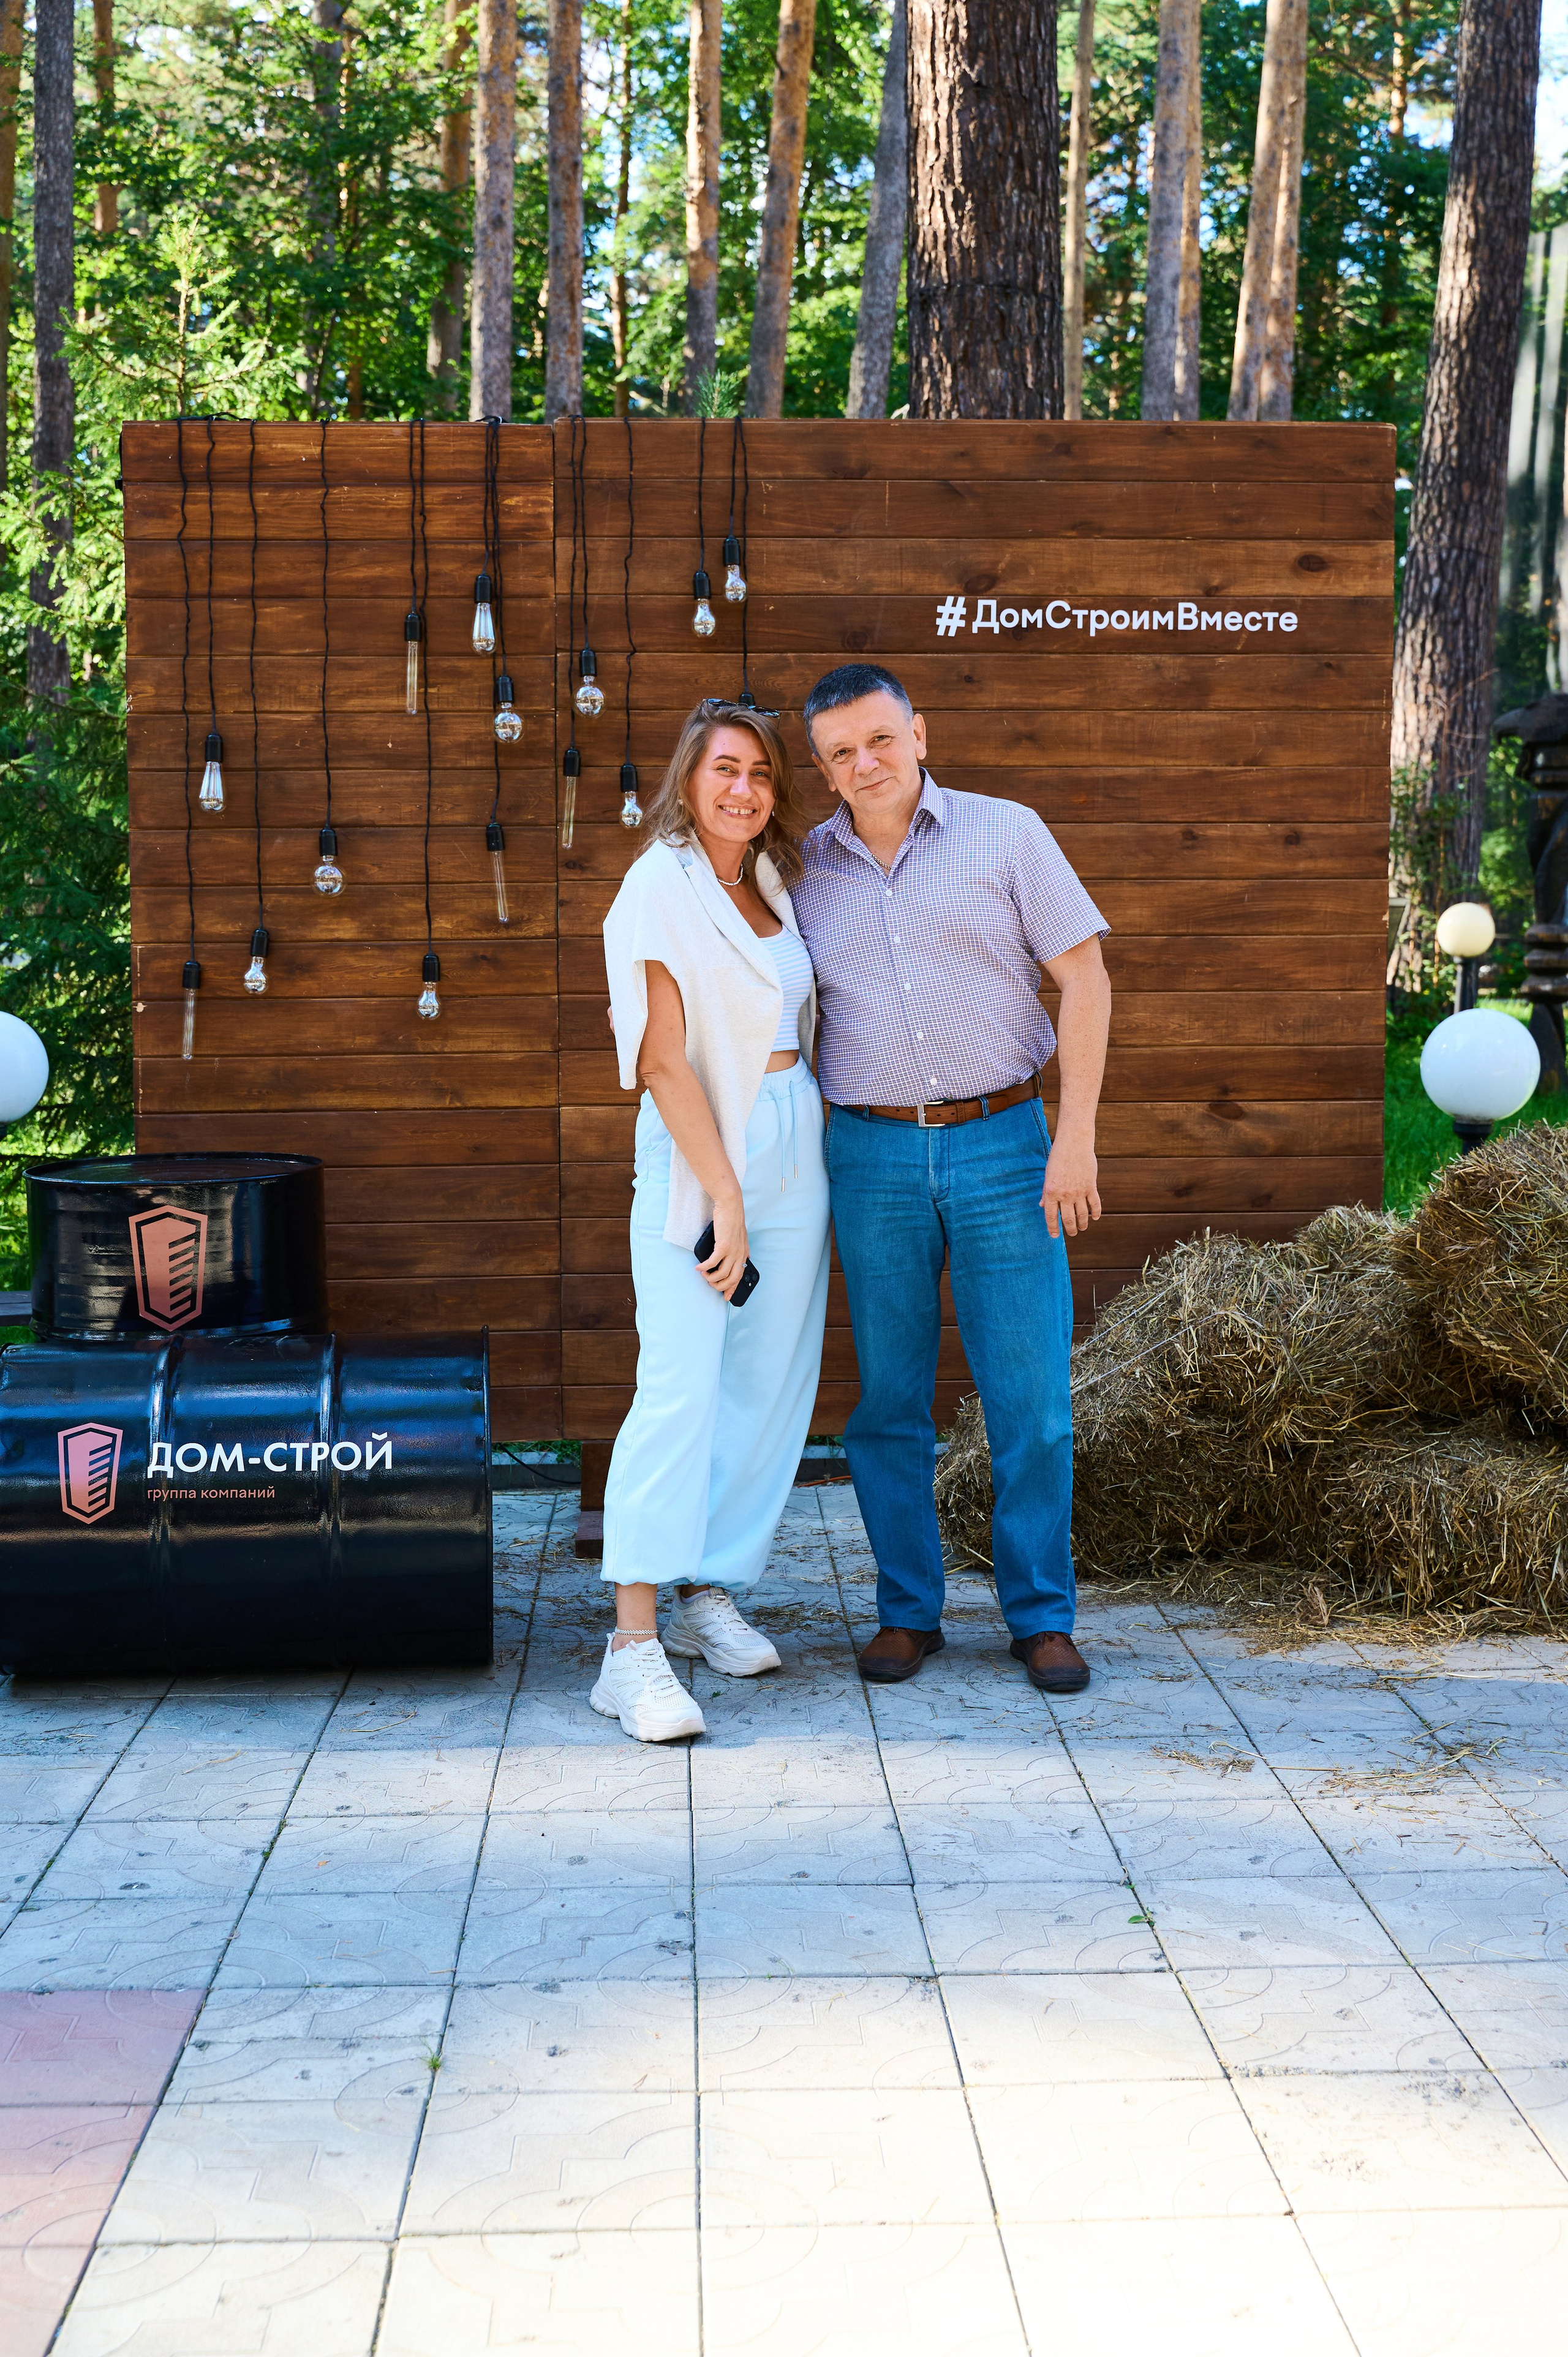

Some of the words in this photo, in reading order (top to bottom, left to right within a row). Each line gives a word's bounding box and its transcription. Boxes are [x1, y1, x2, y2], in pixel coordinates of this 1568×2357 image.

[935, 596, 1298, 636] #ДомСтроимВместе
[147, 1431, 393, 1479] ДОМ-СТРОЙ
[147, 1489, 197, 1501] группа
[201, 1486, 275, 1498] компаний
